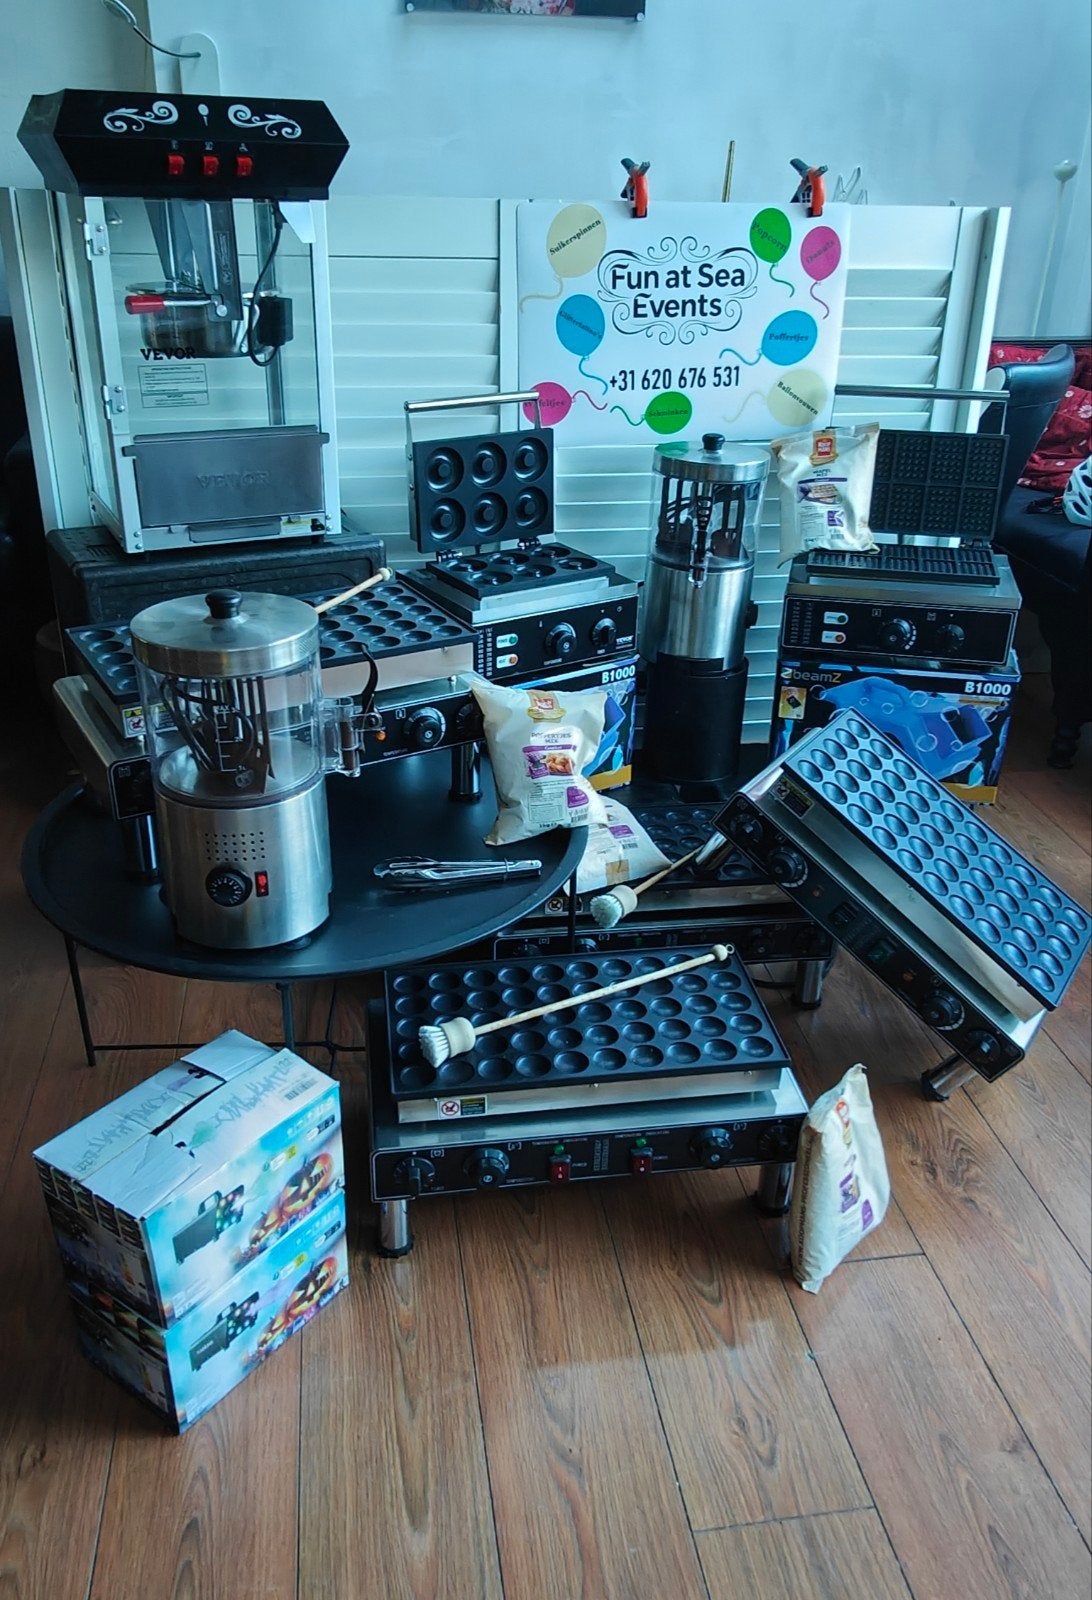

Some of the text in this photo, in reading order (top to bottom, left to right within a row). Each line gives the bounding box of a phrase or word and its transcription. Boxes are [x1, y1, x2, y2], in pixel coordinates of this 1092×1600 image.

[550, 218, 602, 257] Suikerspinnen
[752, 222, 787, 252] Popcorn
[610, 263, 746, 290] Fun at Sea
[632, 293, 722, 318] Events
[768, 332, 810, 343] Poffertjes
[140, 347, 197, 361] VEVOR
[609, 366, 740, 391] +31 620 676 531
[524, 398, 565, 408] Wfeltjes
[196, 471, 270, 490] VEVOR
[602, 664, 636, 684] B1000
[793, 669, 841, 684] beamZ
[964, 681, 1012, 696] B1000
